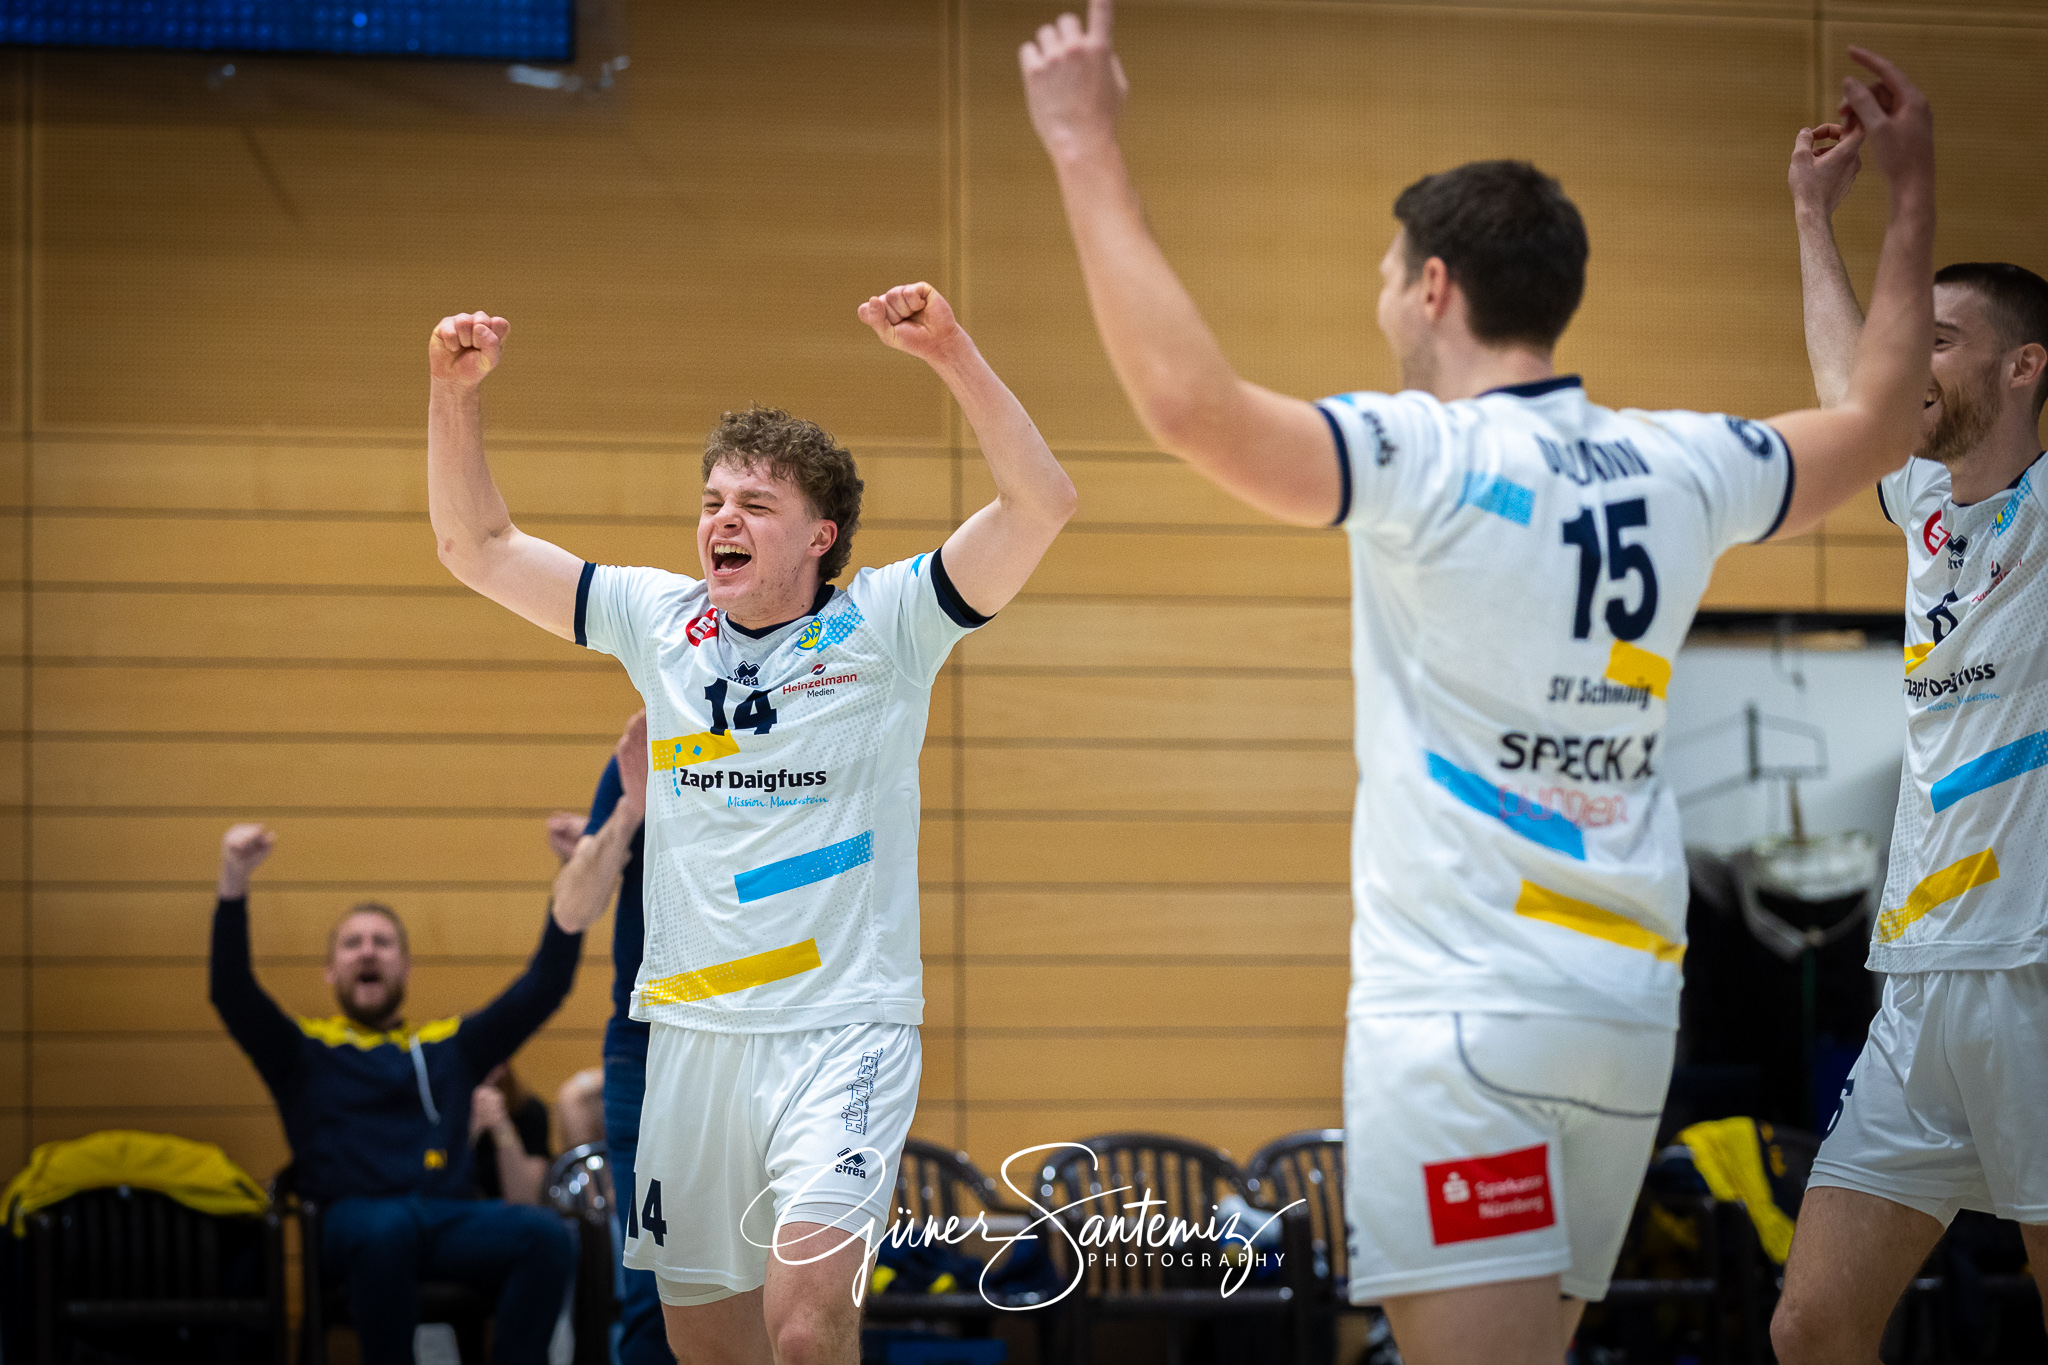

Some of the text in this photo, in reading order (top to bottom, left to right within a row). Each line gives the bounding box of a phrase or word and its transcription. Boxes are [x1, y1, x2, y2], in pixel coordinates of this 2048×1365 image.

[1560, 498, 1659, 642] 15
[782, 673, 858, 695] Heinzelmann
[807, 687, 835, 698] Medien
[704, 677, 778, 736] 14
[1499, 731, 1632, 782] SPECK
[680, 768, 827, 793] Zapf Daigfuss
[770, 795, 829, 809] Mauerstein
